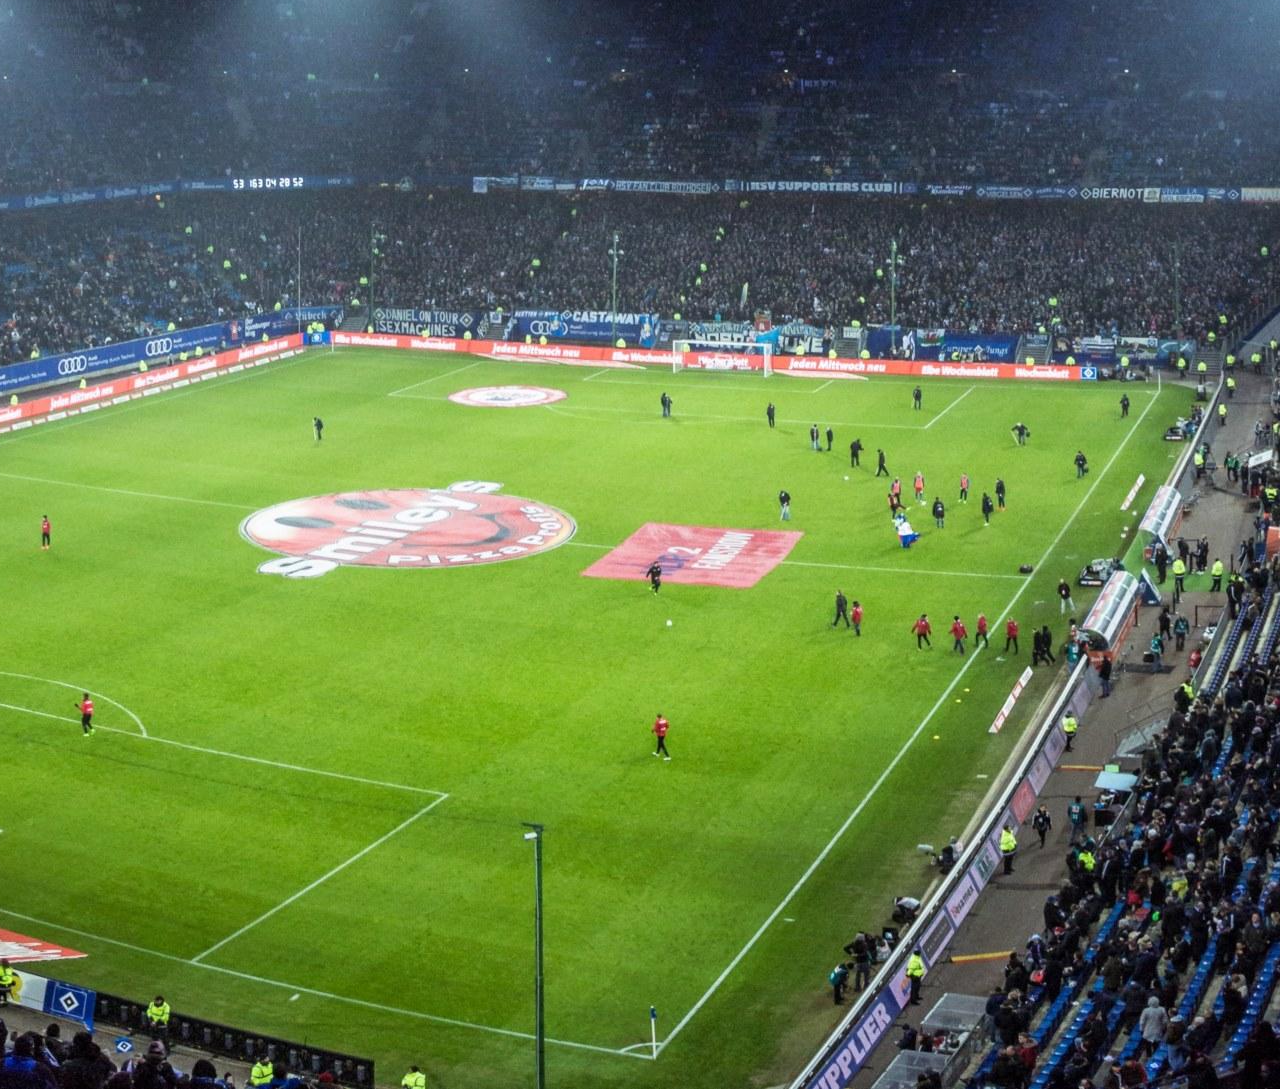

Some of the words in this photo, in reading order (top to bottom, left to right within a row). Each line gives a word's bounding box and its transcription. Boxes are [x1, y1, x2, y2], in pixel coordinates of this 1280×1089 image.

[233, 179, 244, 189] 53
[249, 178, 263, 188] 163
[266, 178, 277, 188] 04
[279, 177, 290, 187] 28
[293, 177, 304, 187] 52
[751, 181, 777, 192] HSV
[778, 181, 859, 192] SUPPORTERS
[861, 182, 893, 193] CLUB
[1092, 187, 1144, 199] BIERNOT
[385, 309, 417, 322] DANIEL
[419, 311, 431, 322] ON
[433, 311, 459, 325] TOUR
[572, 311, 640, 325] CASTAWAY
